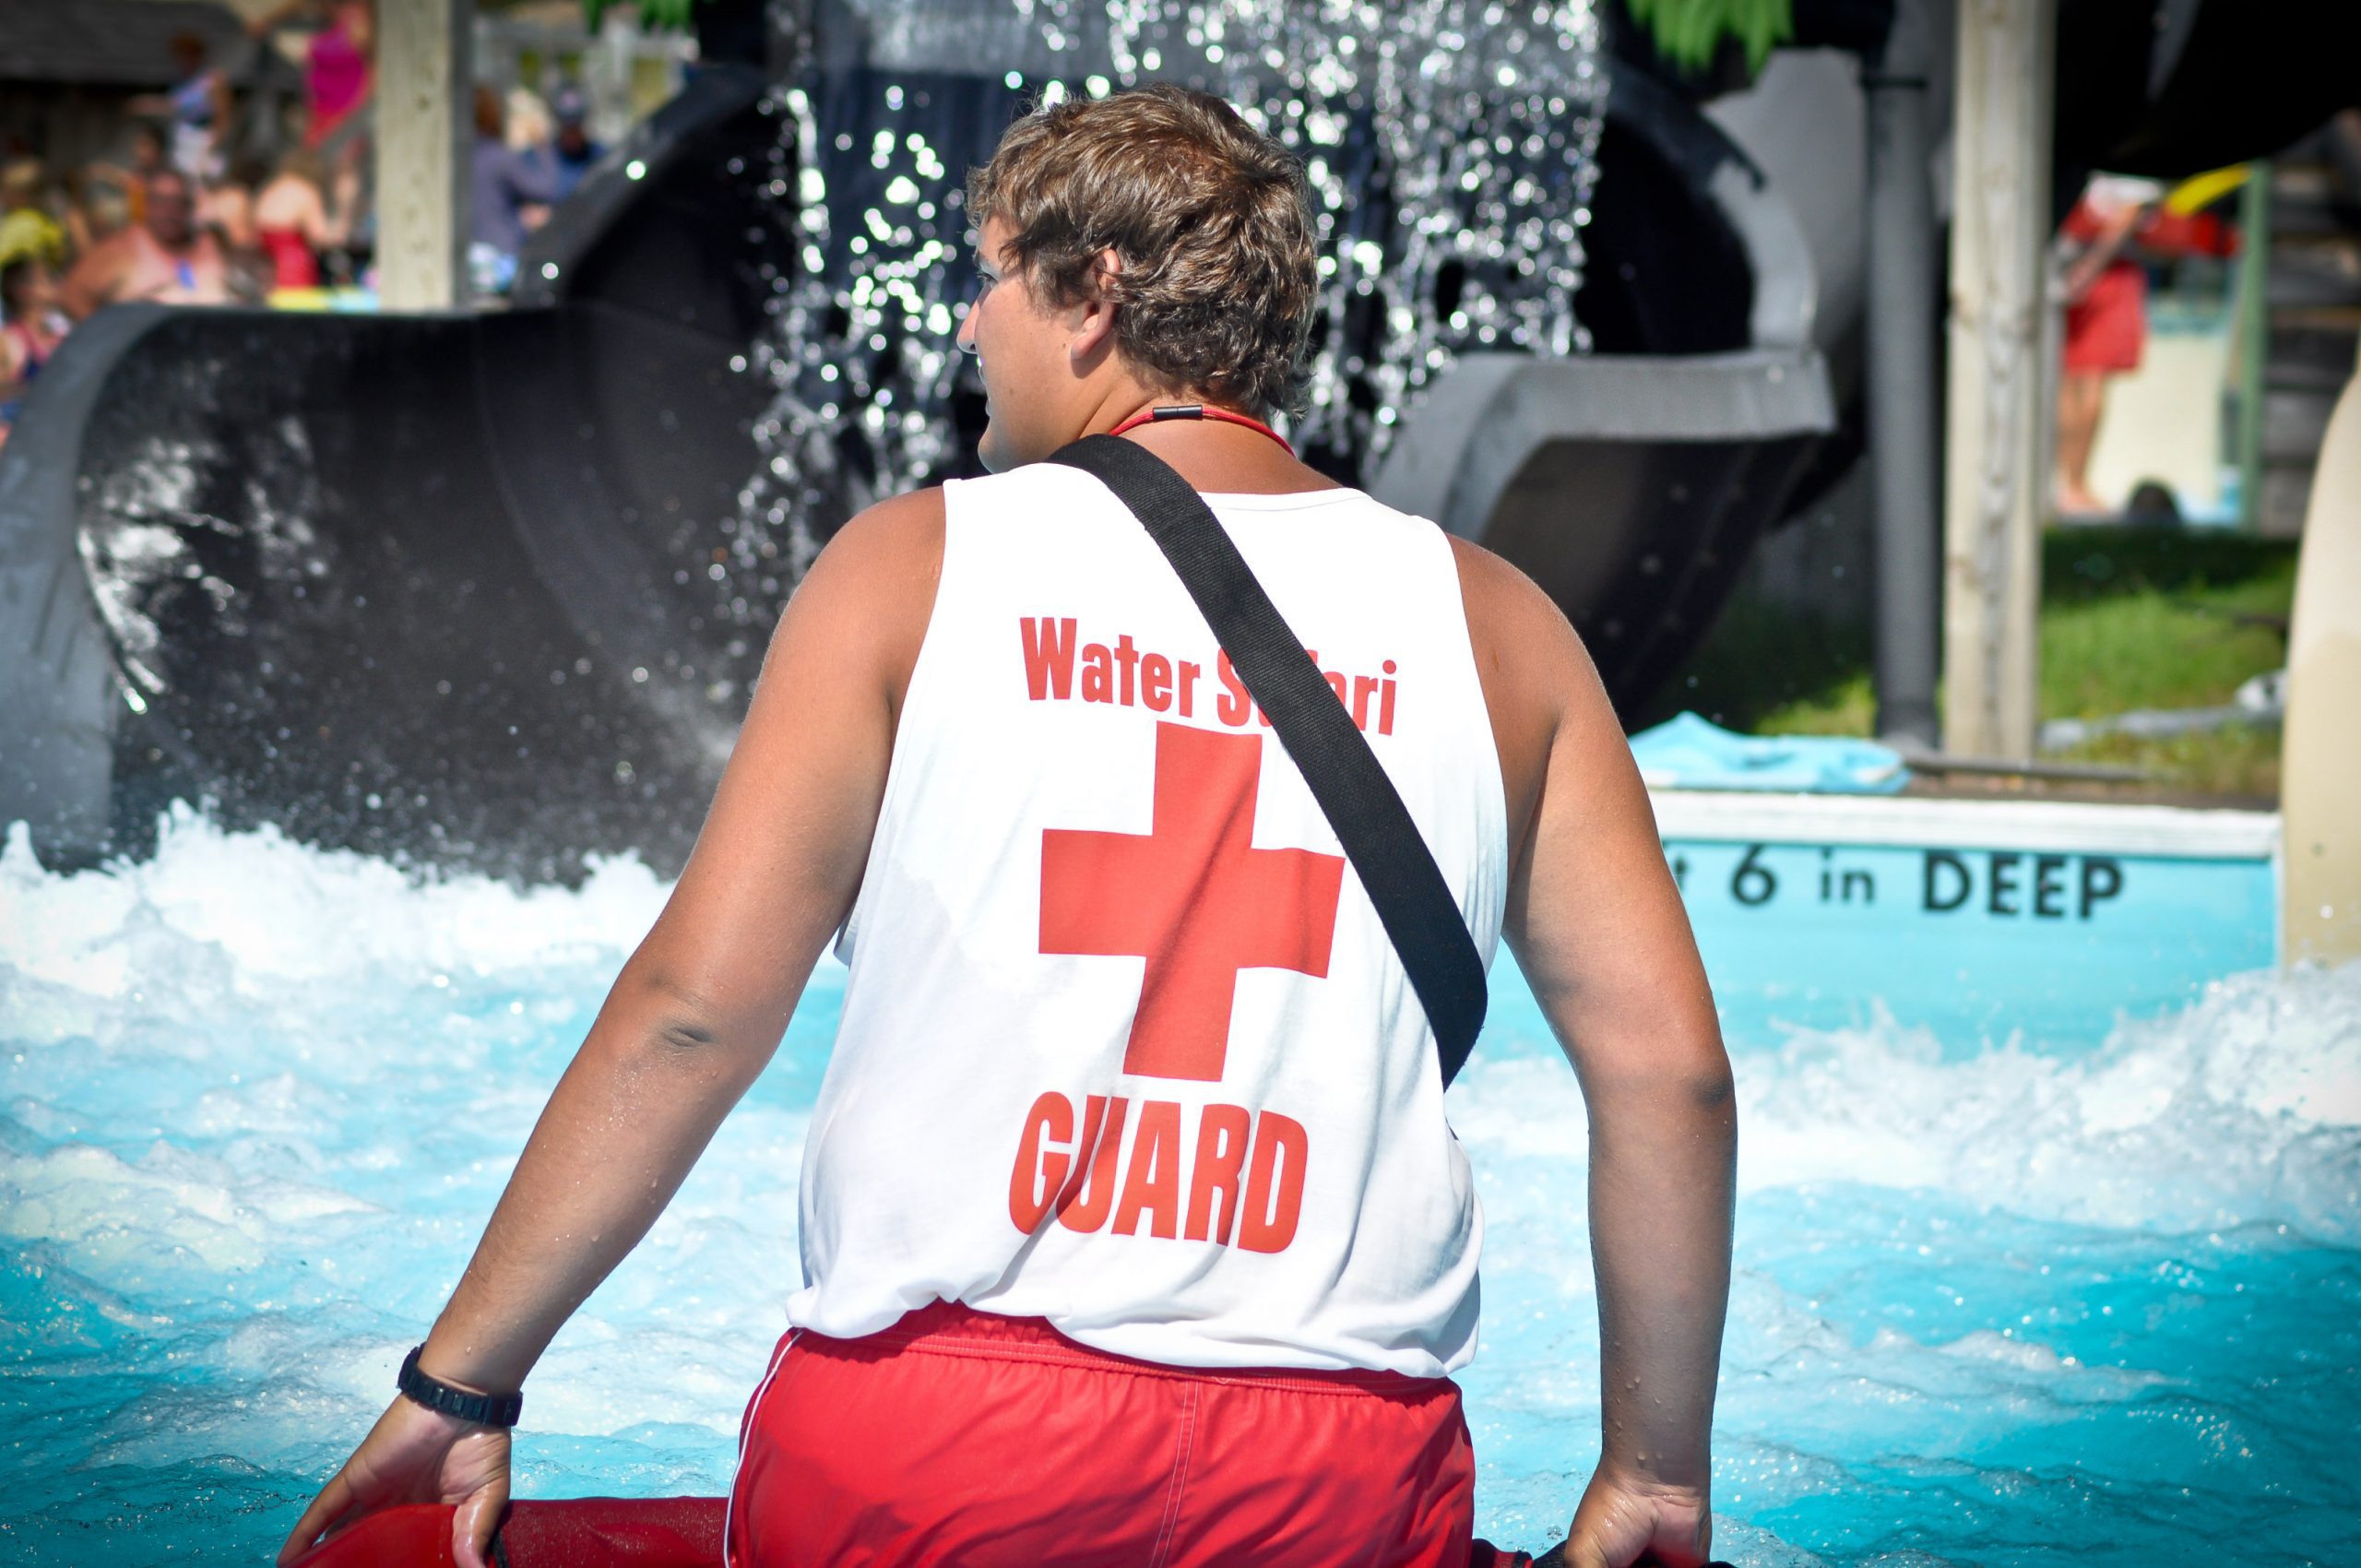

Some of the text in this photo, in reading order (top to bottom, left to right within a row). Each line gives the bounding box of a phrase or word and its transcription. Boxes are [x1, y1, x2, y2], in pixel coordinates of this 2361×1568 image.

[1020, 617, 1397, 736] Water Sri
[1731, 843, 1777, 906] 6
[1820, 846, 1875, 902] in
[1923, 849, 2125, 920] DEEP
[1009, 1091, 1309, 1253] GUARD
